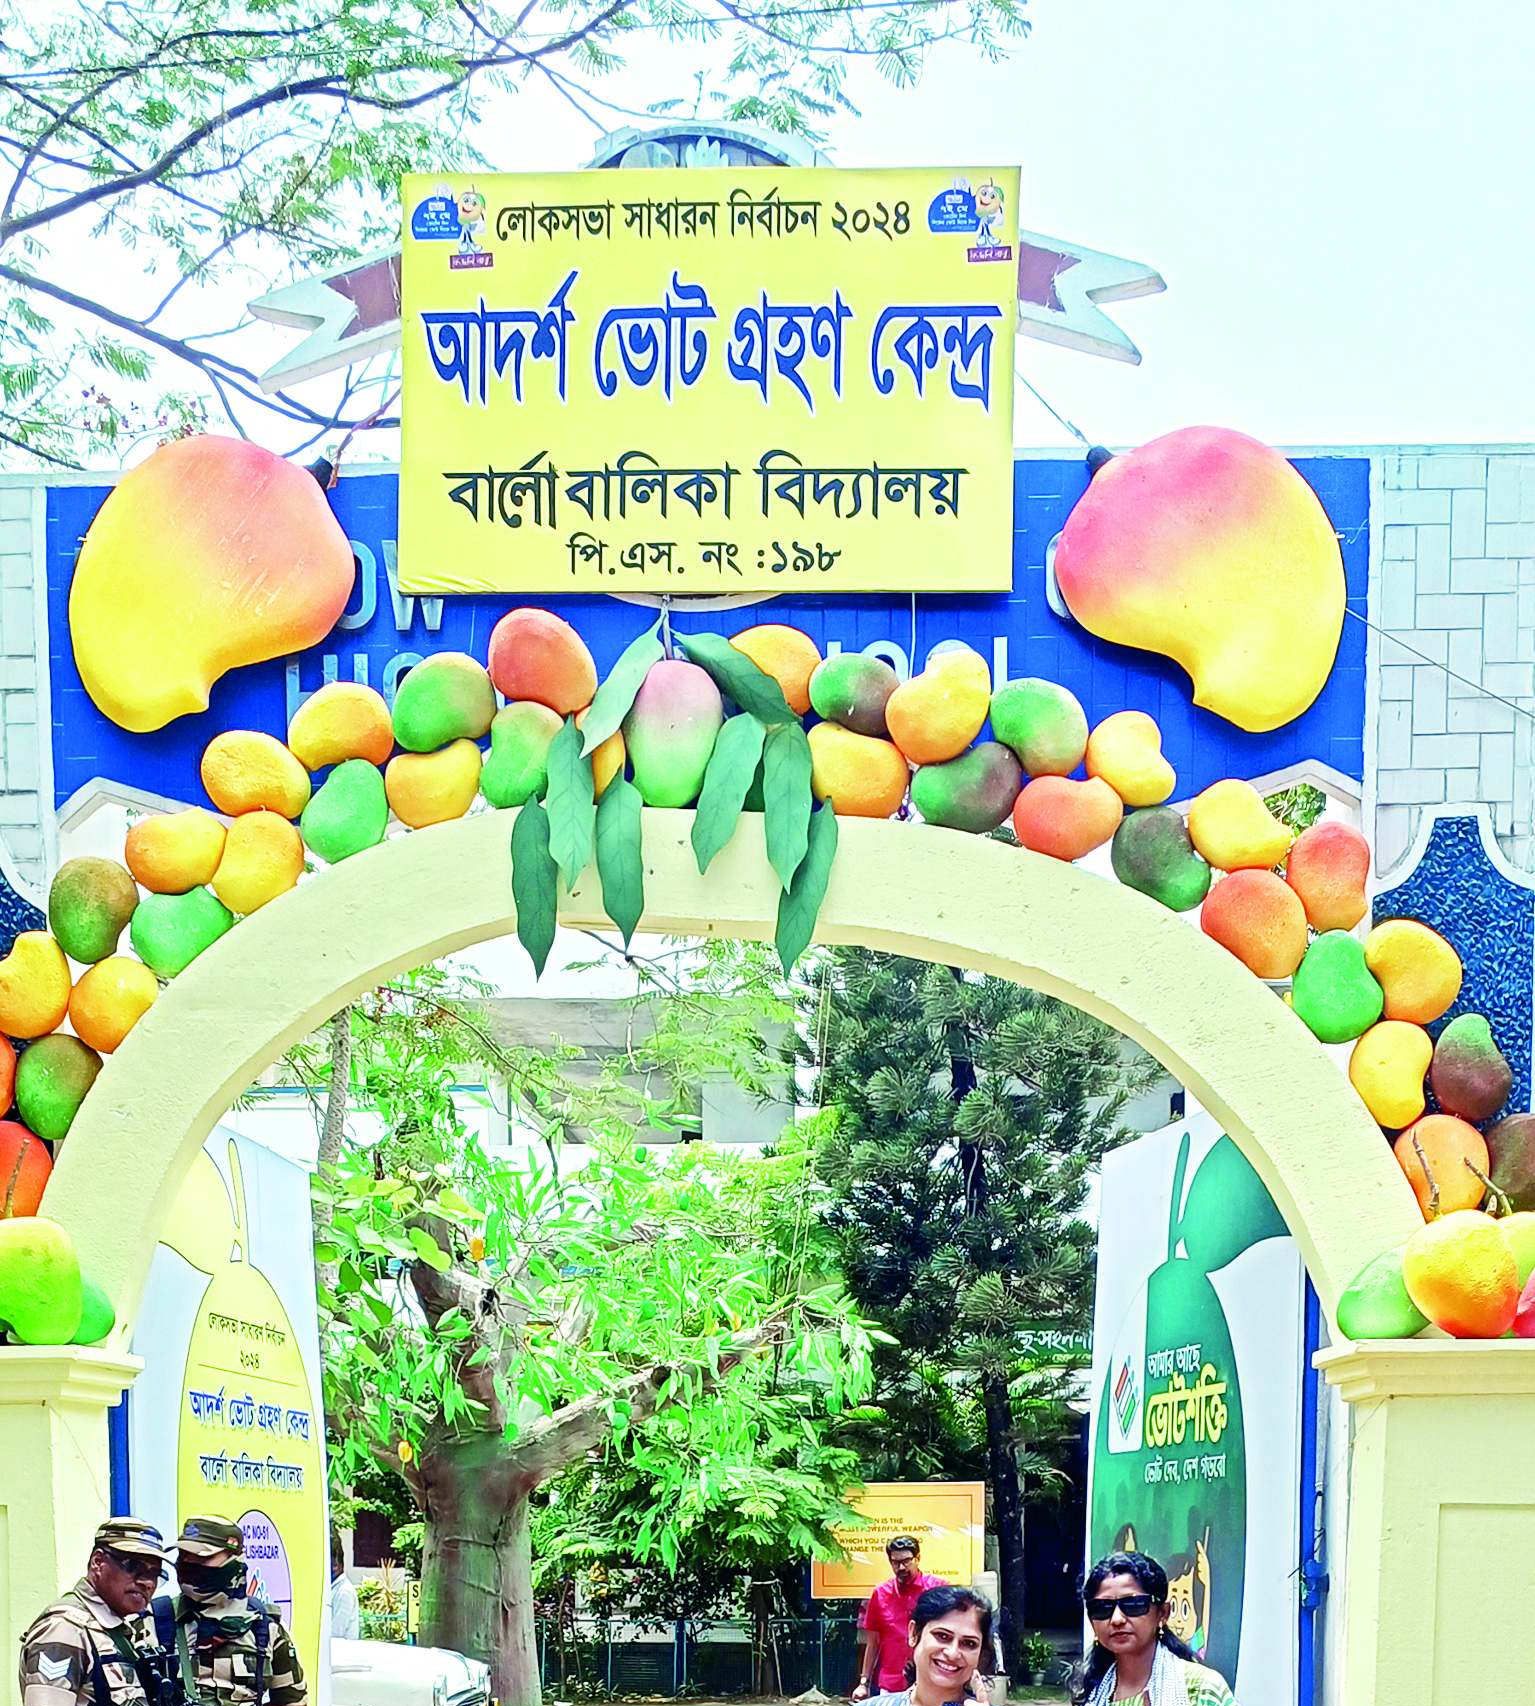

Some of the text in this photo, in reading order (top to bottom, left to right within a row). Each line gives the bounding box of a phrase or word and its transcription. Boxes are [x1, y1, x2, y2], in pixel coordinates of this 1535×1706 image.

[496, 187, 910, 242] লোকসভা সাধারন নির্বাচন ২০২৪
[421, 270, 1003, 415] আদর্শ ভোট গ্রহণ কেন্দ্র
[443, 450, 968, 529] বার্লো বালিকা বিদ্যালয়
[566, 532, 685, 577] পি.এস.
[702, 541, 740, 577] নং
[208, 1312, 238, 1336] লোকসভা
[265, 1322, 286, 1349] নির্বাচন
[239, 1350, 260, 1372] ২০২৪
[1147, 1343, 1201, 1378] আমার আছে
[189, 1386, 311, 1441] আদর্শ ভোট গ্রহণ কেন্দ্র
[1145, 1363, 1228, 1448] ভোটশক্তি
[200, 1449, 303, 1491] বার্লো বালিকা বিদ্যালয়
